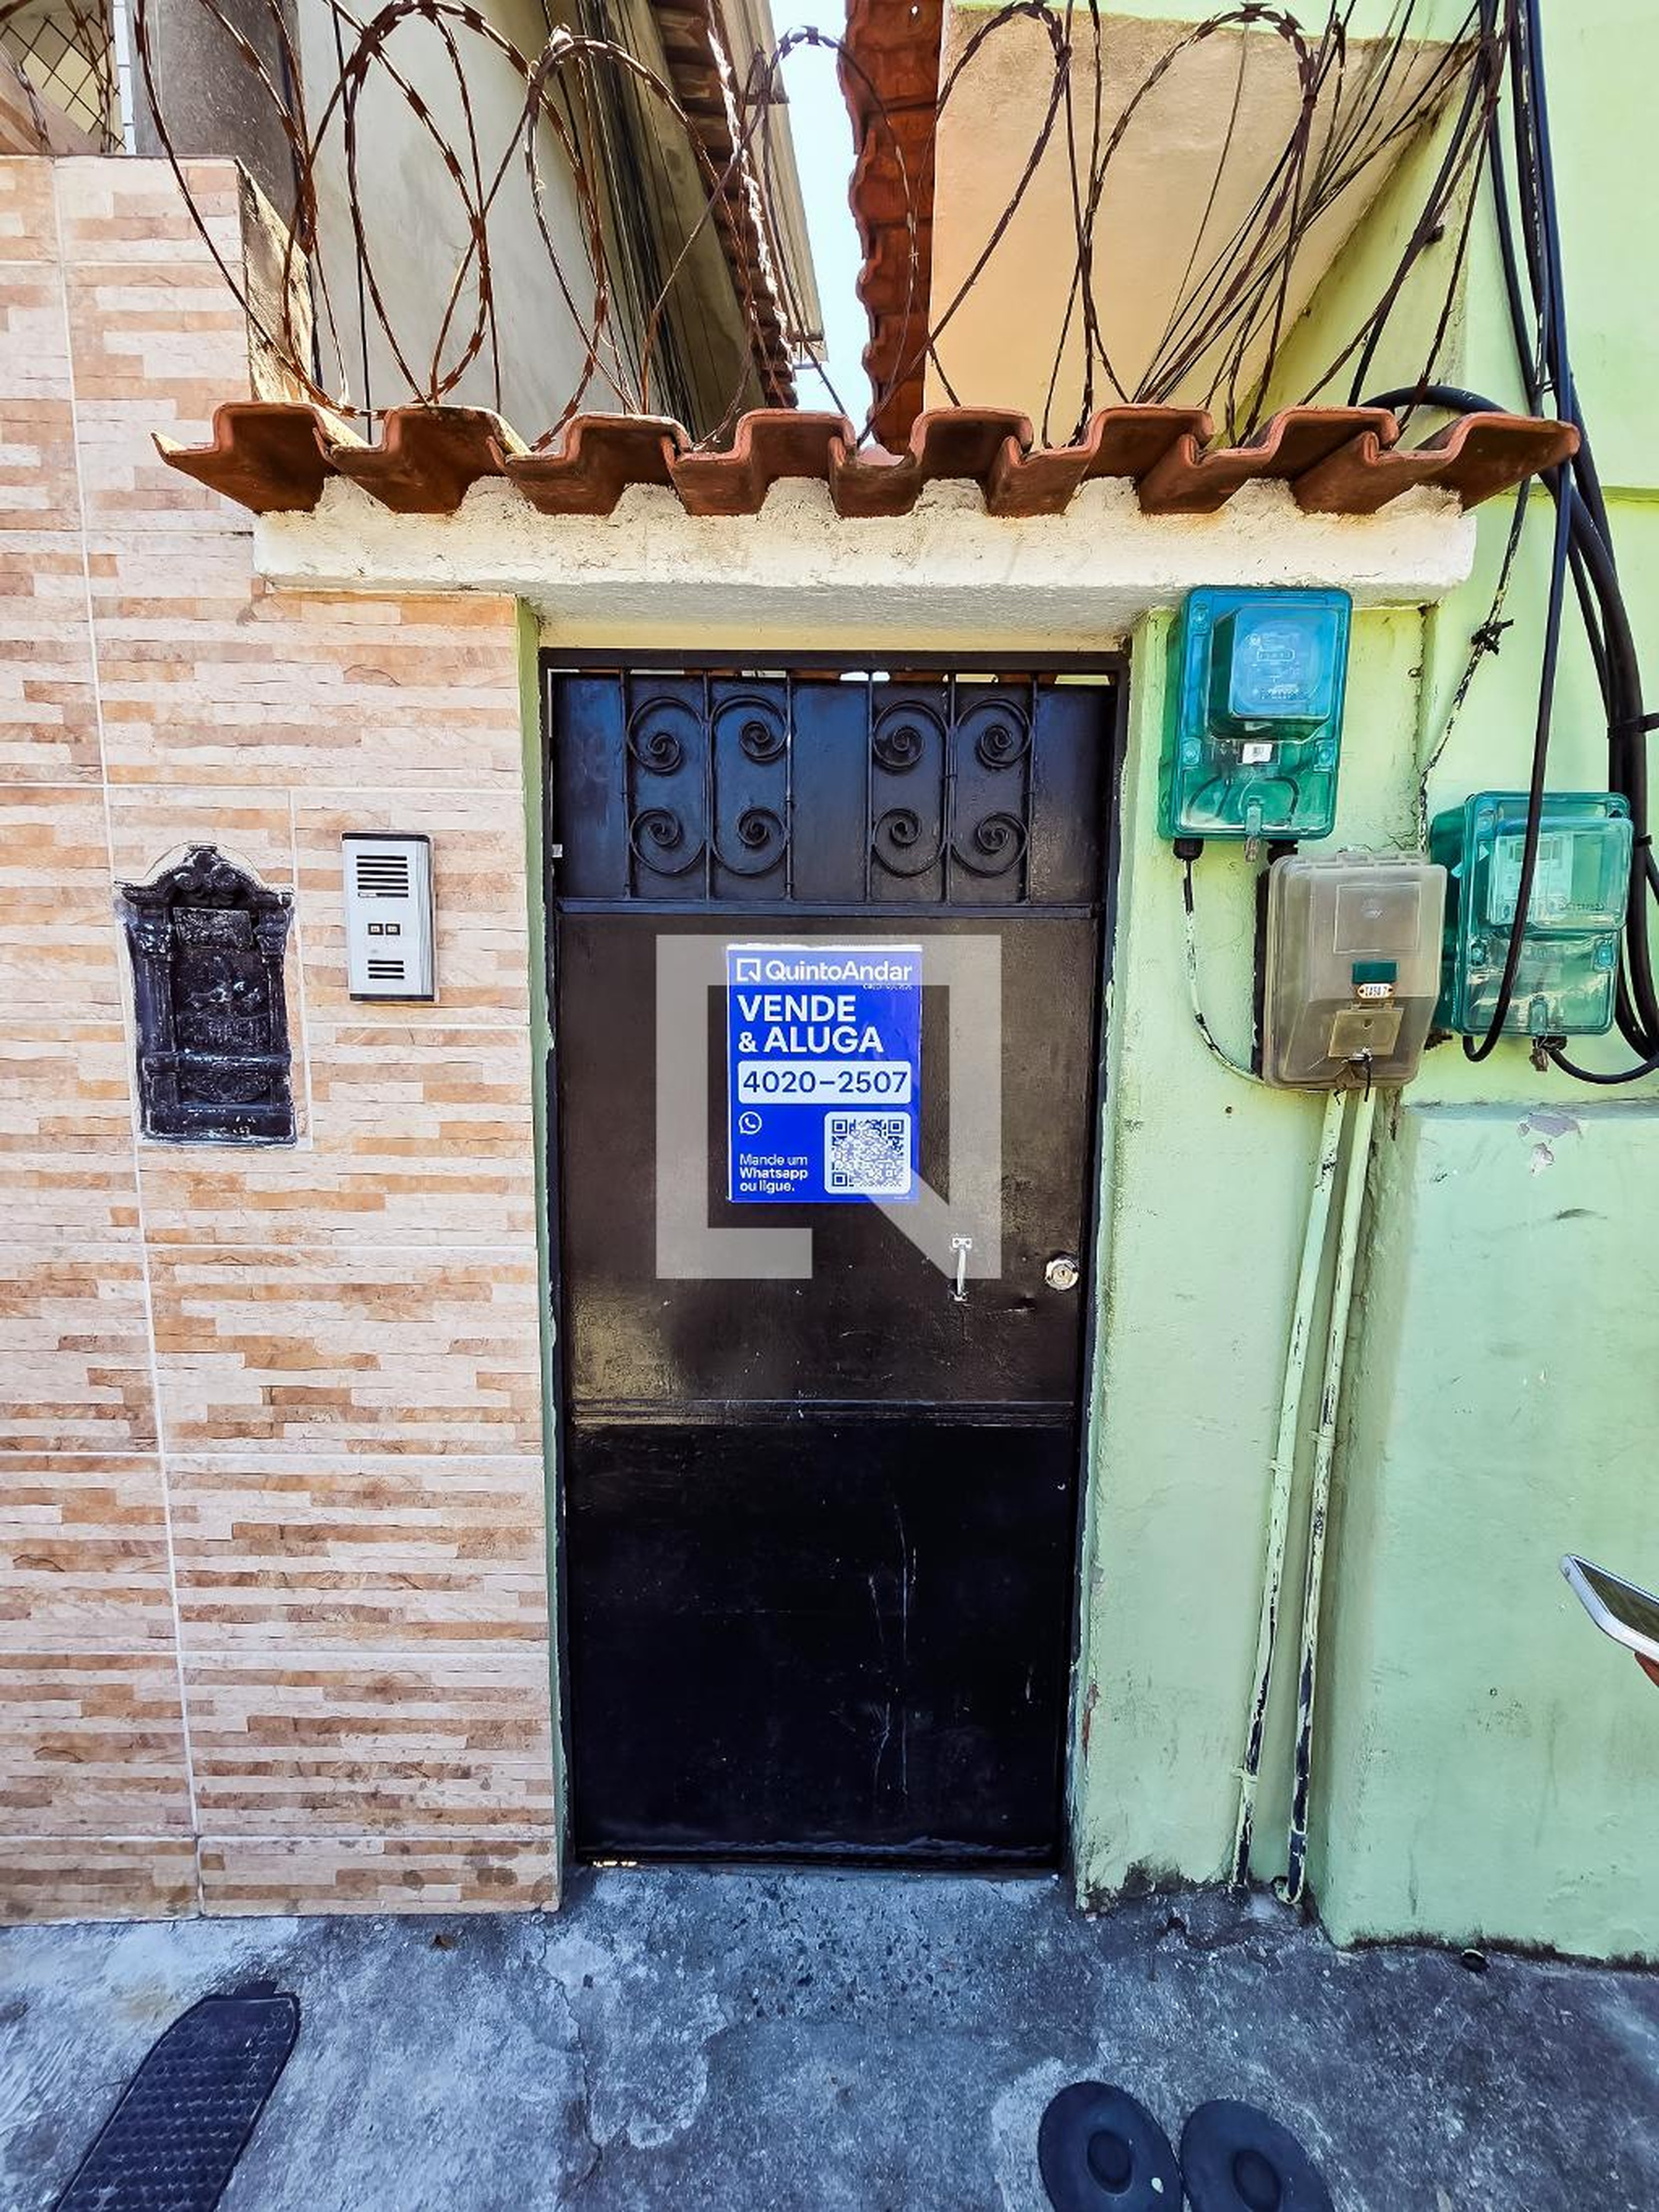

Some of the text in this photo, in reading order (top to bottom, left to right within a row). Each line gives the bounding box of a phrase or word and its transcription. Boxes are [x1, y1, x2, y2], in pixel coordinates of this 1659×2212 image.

[766, 959, 912, 982] QuintoAndar
[737, 995, 856, 1022] VENDE
[738, 1026, 884, 1053] & ALUGA
[743, 1070, 908, 1093] 4020-2507
[740, 1153, 808, 1166] Mande um
[740, 1167, 808, 1182] Whatsapp
[740, 1180, 795, 1194] ou ligue.
